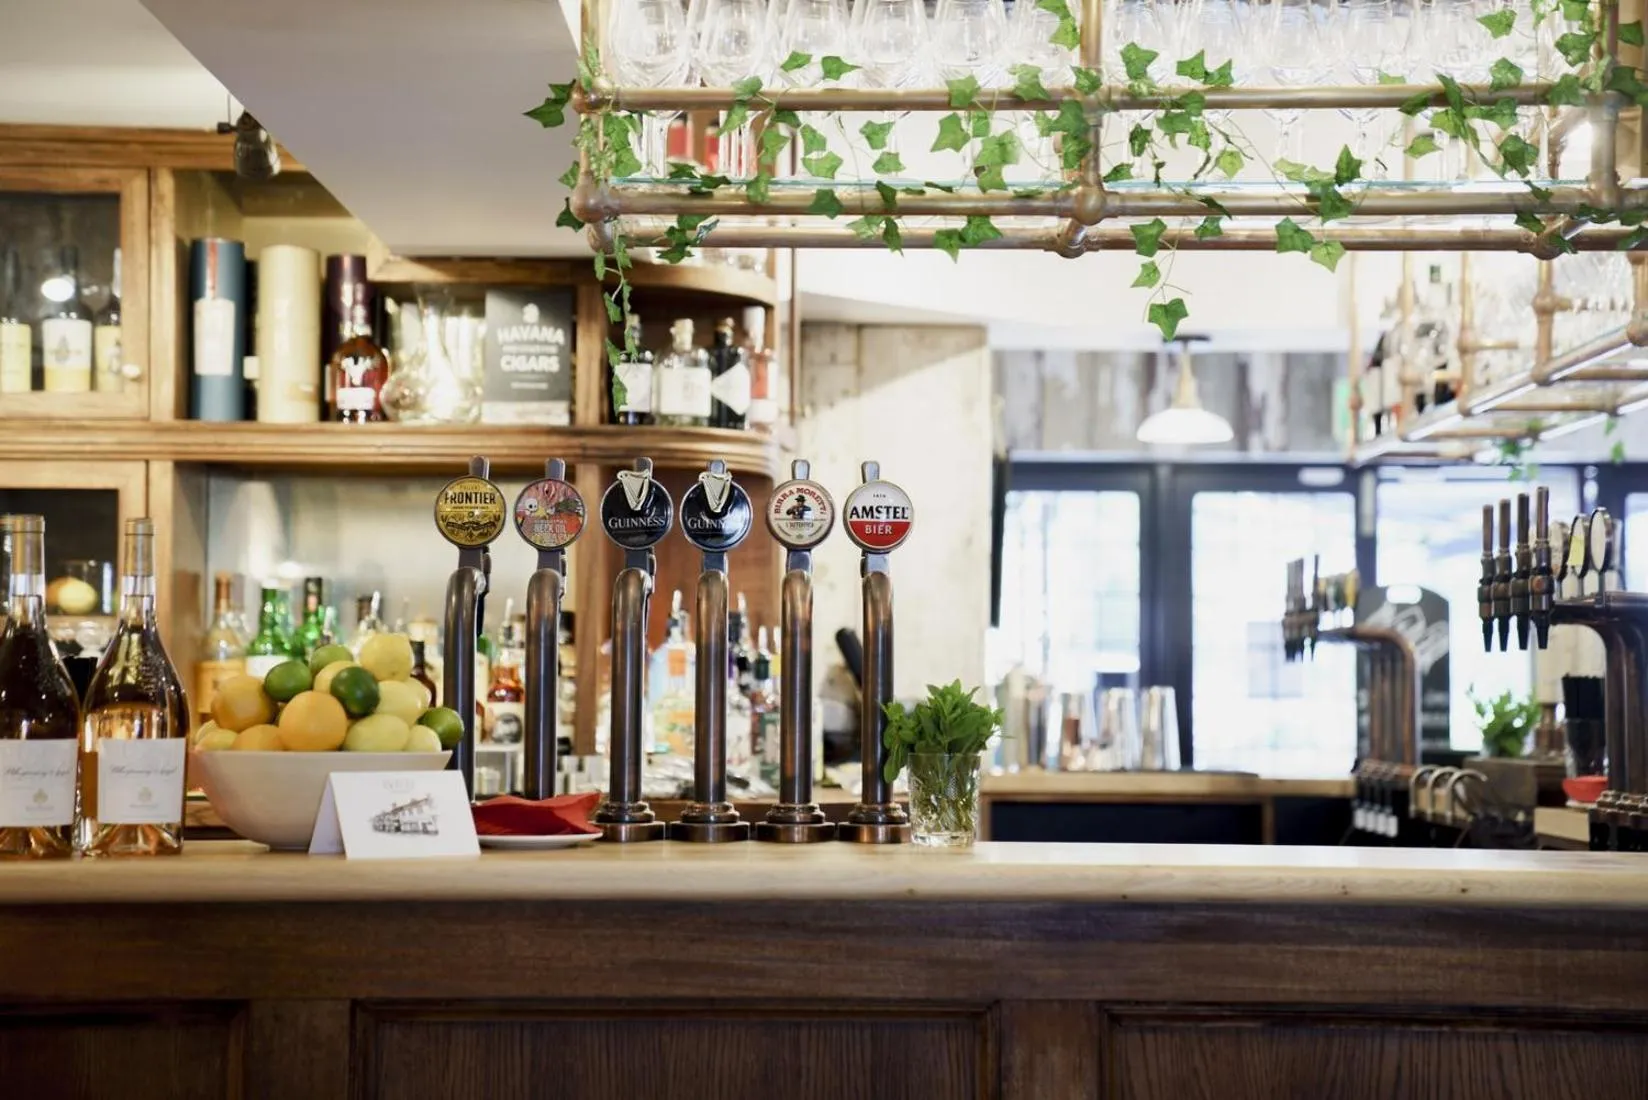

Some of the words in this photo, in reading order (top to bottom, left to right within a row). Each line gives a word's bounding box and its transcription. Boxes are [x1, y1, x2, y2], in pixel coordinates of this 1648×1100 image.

[497, 325, 565, 345] HAVANA
[500, 355, 560, 373] CIGARS
[444, 491, 497, 504] FRONTIER
[774, 489, 795, 514] BIRRA
[796, 487, 827, 515] MORETTI
[849, 505, 909, 519] AMSTEL
[608, 516, 666, 529] GUINNESS
[687, 516, 738, 529] GUINN
[864, 524, 893, 534] BIER
